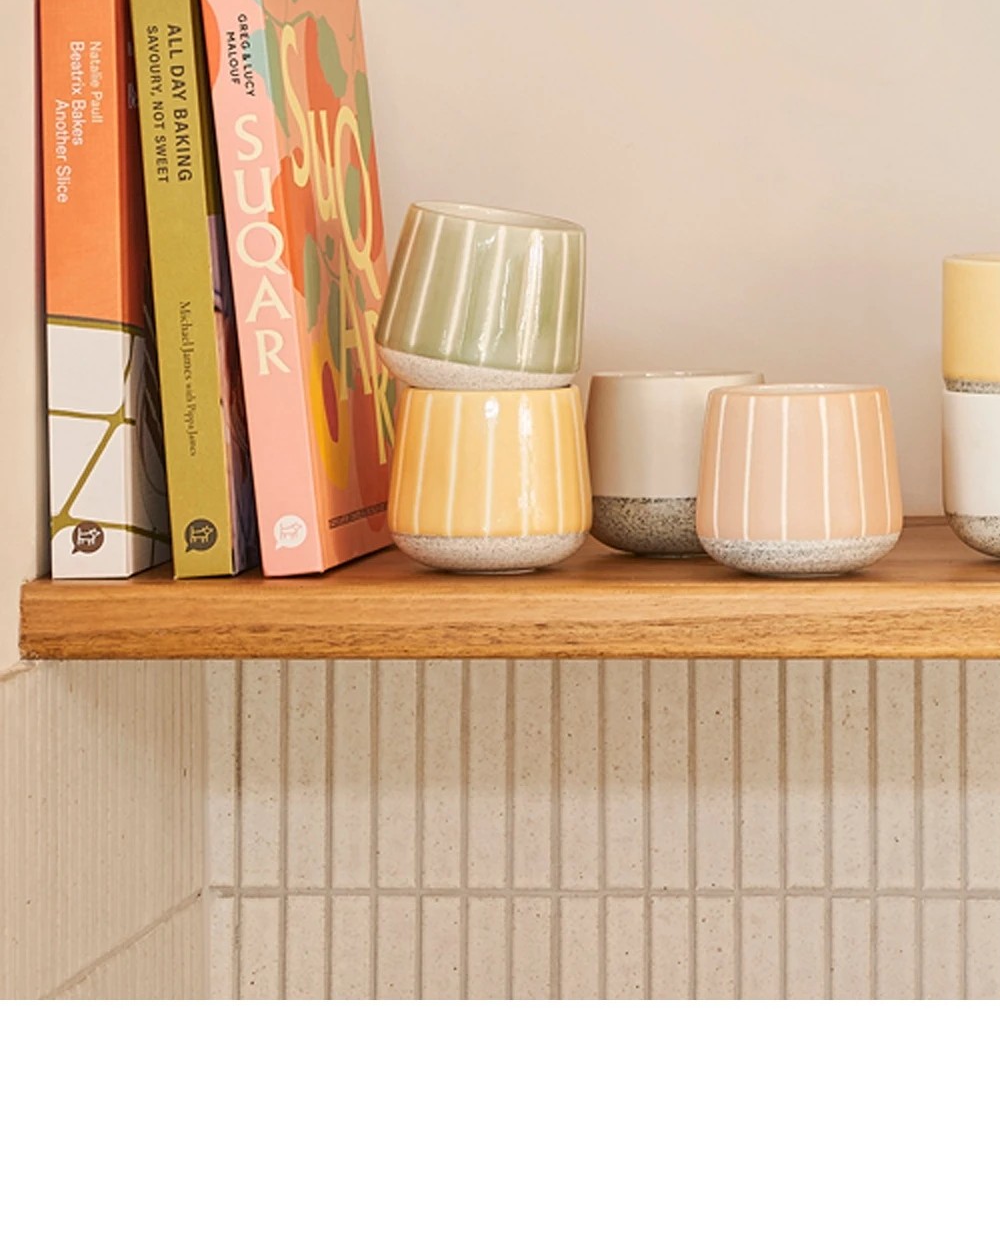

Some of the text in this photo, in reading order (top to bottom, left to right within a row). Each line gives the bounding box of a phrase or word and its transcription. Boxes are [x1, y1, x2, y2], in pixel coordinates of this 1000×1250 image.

[226, 31, 241, 85] MALOUF
[237, 14, 250, 49] GREG
[70, 41, 87, 146] Beatrix Bakes
[89, 41, 104, 123] Natalie Paull
[146, 25, 169, 184] SAVOURY, NOT SWEET
[167, 24, 192, 182] ALL DAY BAKING
[243, 64, 256, 97] LUCY
[55, 99, 72, 203] Another Slice
[180, 301, 195, 347] Michael
[180, 347, 195, 382] James
[186, 430, 199, 457] James
